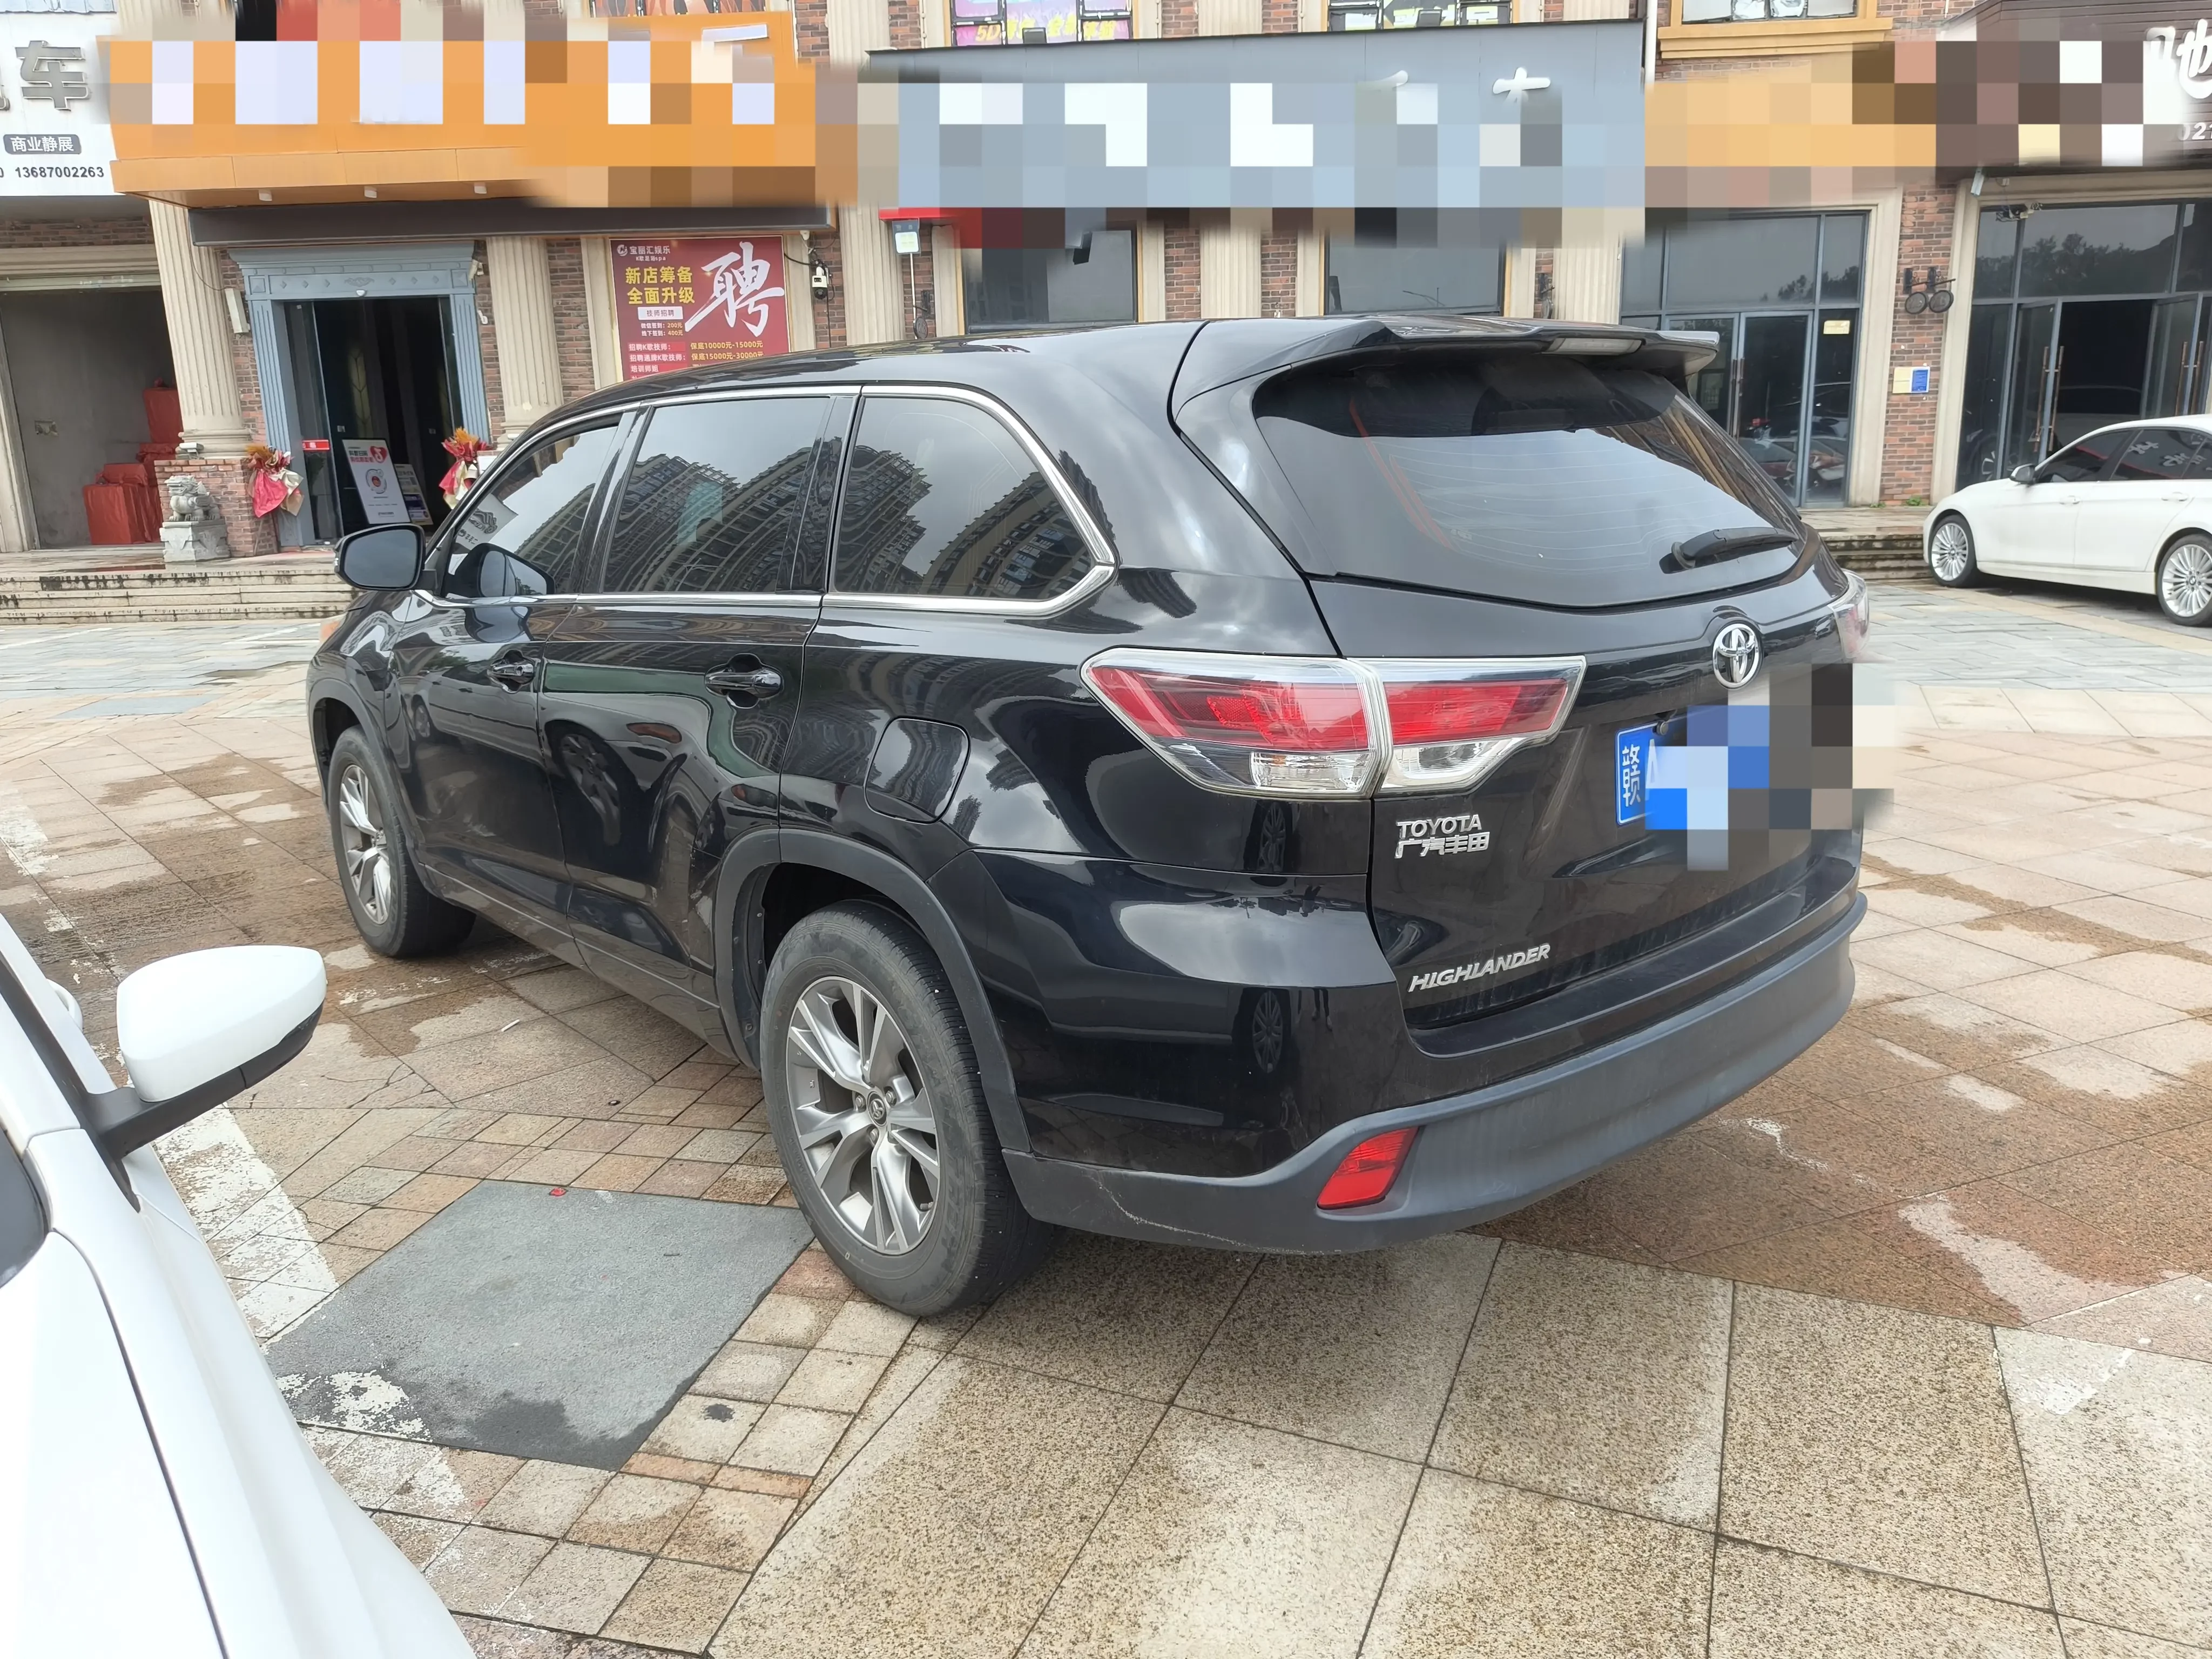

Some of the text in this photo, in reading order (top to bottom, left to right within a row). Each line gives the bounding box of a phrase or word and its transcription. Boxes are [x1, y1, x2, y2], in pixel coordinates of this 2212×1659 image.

[0, 40, 89, 111] 车
[10, 136, 75, 152] 商业静展
[15, 166, 104, 178] 13687002263
[625, 266, 693, 285] 新店筹备
[627, 287, 695, 305] 全面升级
[684, 241, 785, 337] 聘
[1396, 814, 1482, 838] TOYOTA
[1394, 832, 1490, 859] 广汽丰田
[1408, 943, 1551, 993] HIGHLANDER
